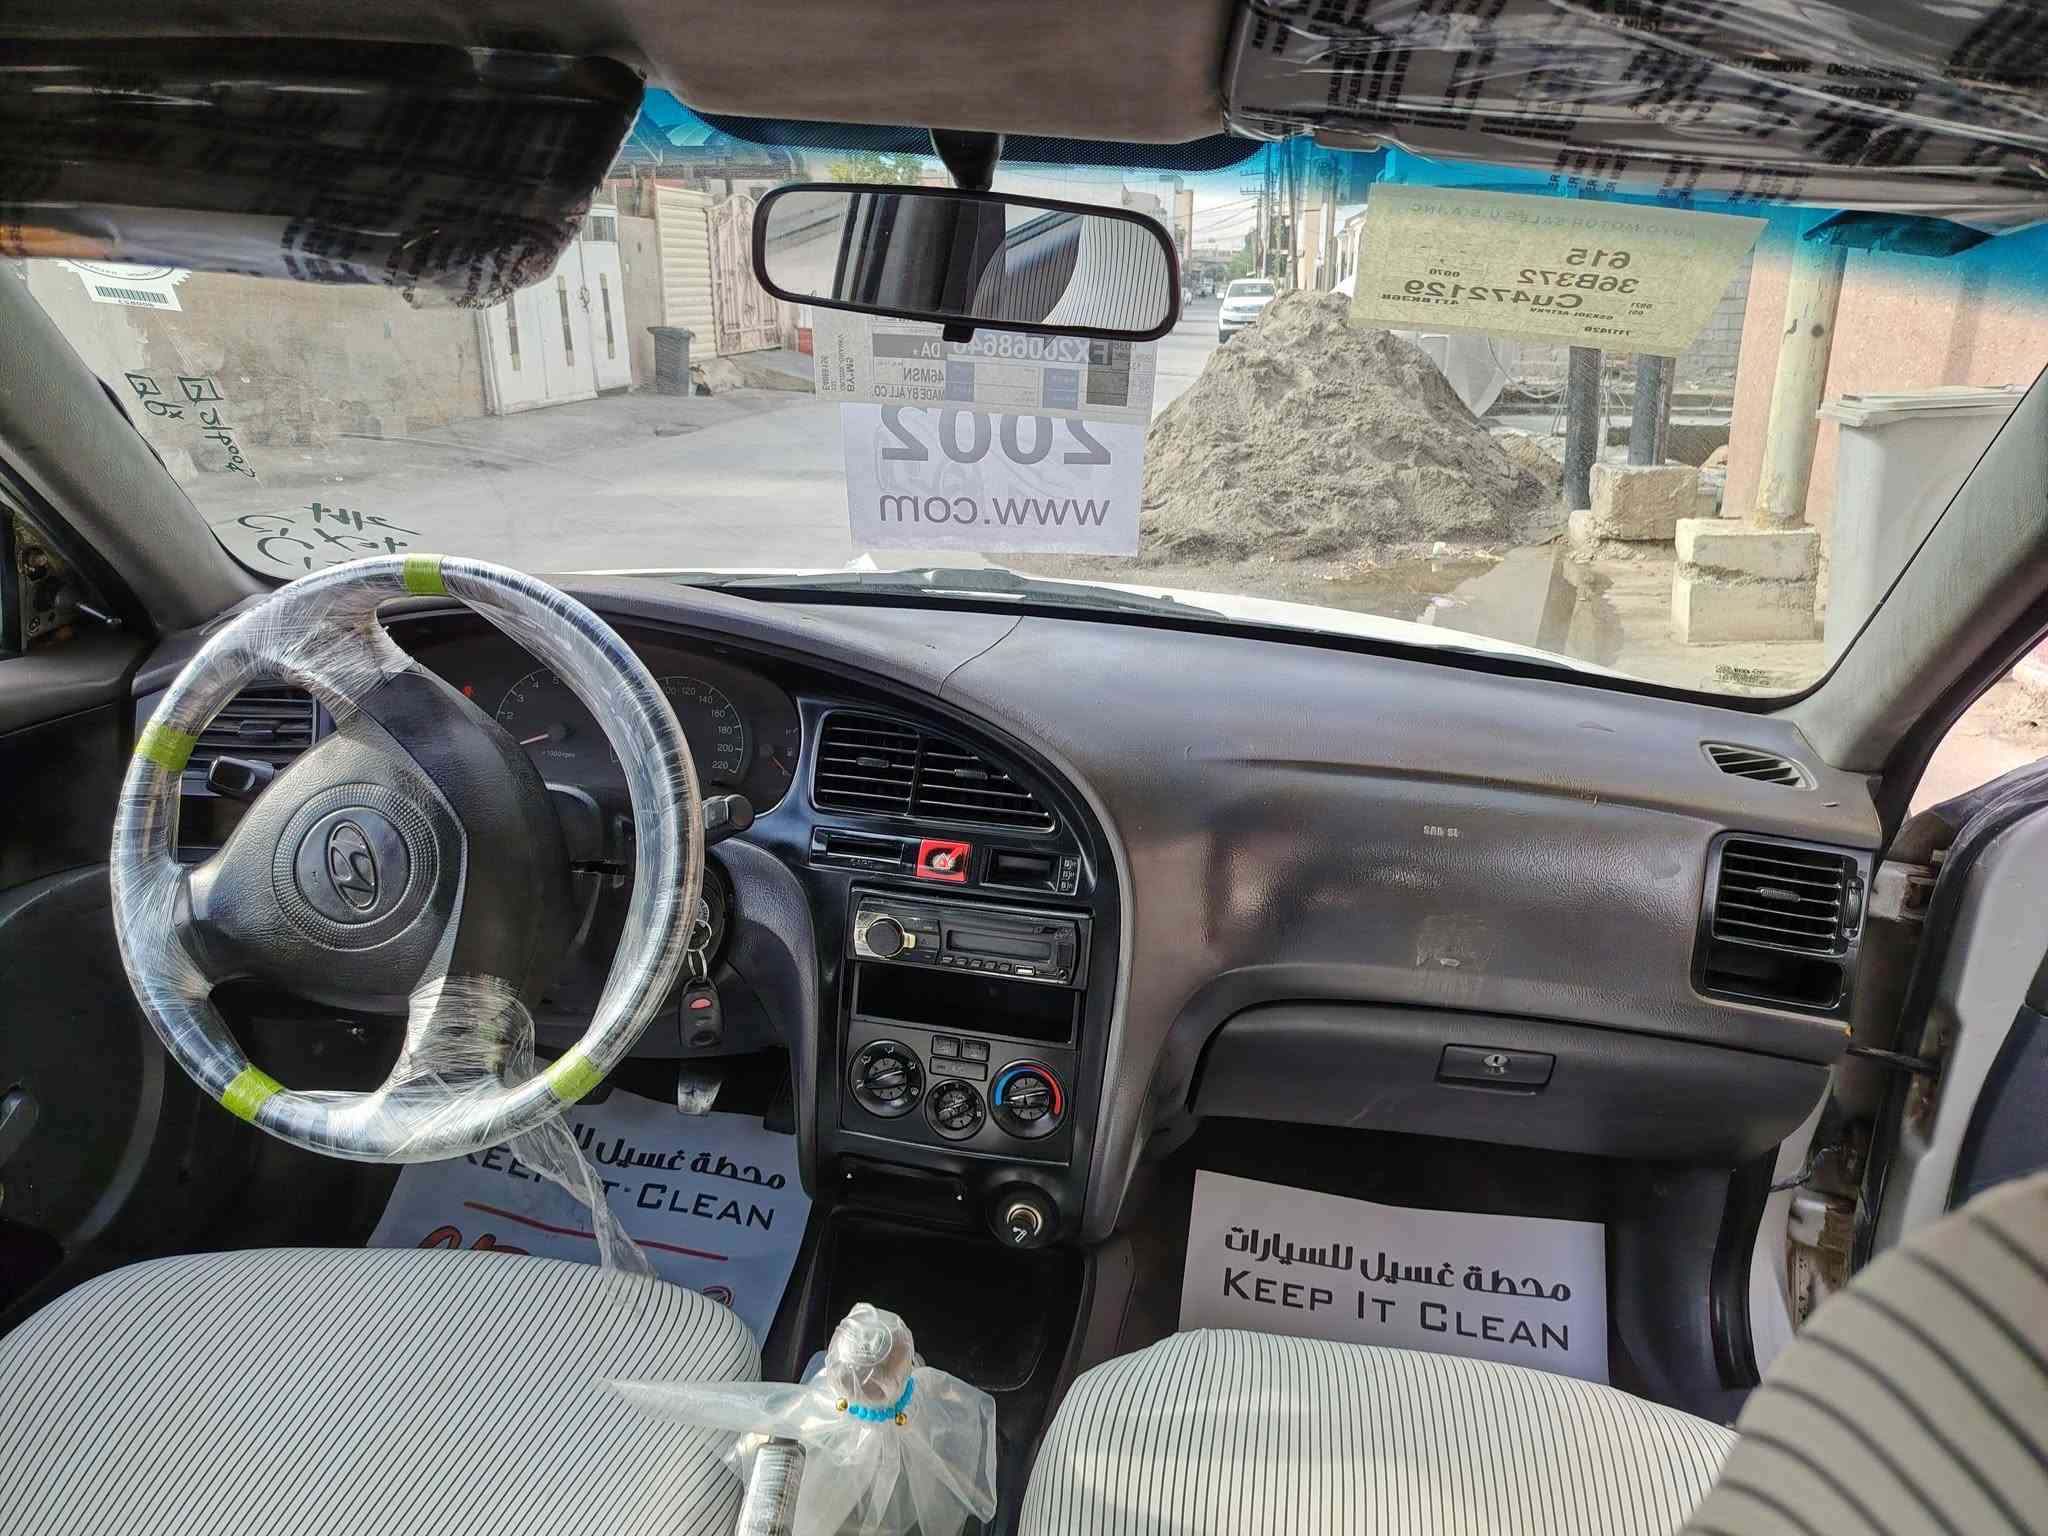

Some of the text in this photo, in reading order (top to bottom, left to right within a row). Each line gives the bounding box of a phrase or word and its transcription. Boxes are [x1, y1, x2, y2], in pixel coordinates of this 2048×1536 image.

[598, 1138, 786, 1190] محطة غسيل
[636, 1182, 774, 1231] CLEAN
[1224, 1226, 1571, 1302] محطة غسيل للسيارات
[1223, 1267, 1569, 1351] KEEP IT CLEAN
